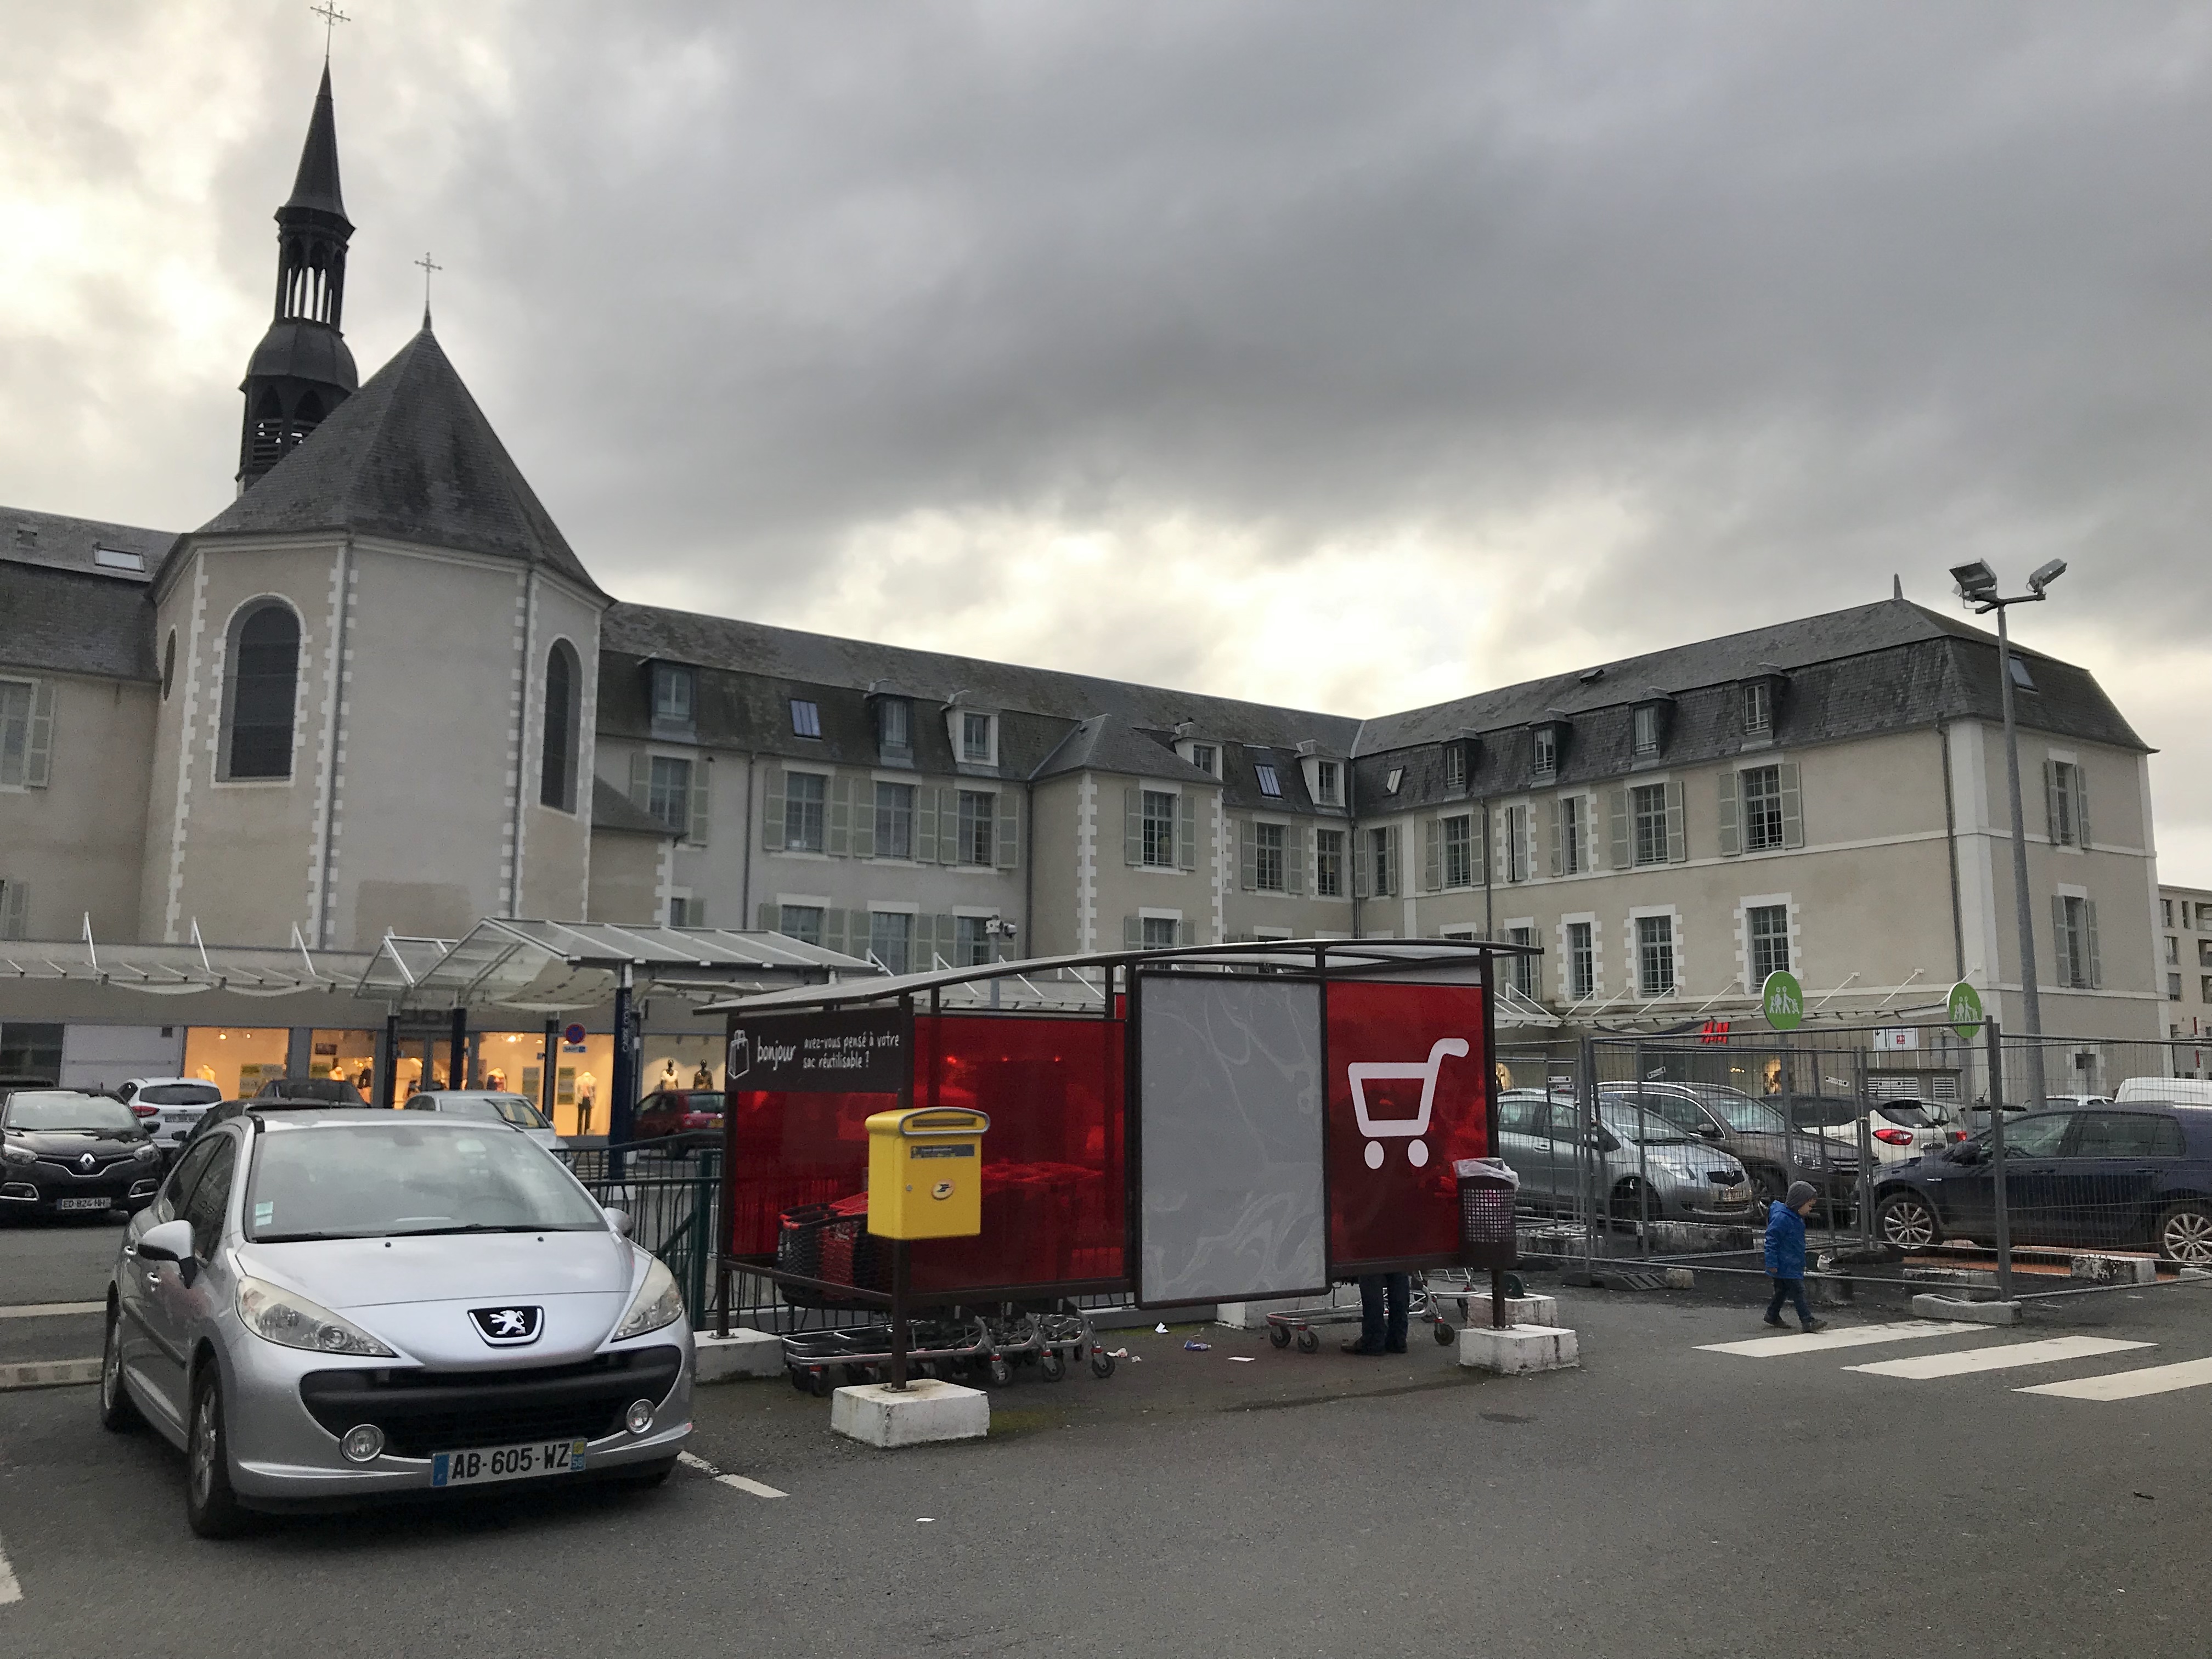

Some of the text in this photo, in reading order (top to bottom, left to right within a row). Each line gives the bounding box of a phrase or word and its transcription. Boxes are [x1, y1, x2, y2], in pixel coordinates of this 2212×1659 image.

[757, 1035, 796, 1071] bonjour
[804, 1030, 899, 1054] avez-vous pensé à votre
[803, 1057, 816, 1069] sac
[819, 1049, 863, 1069] réutilisable
